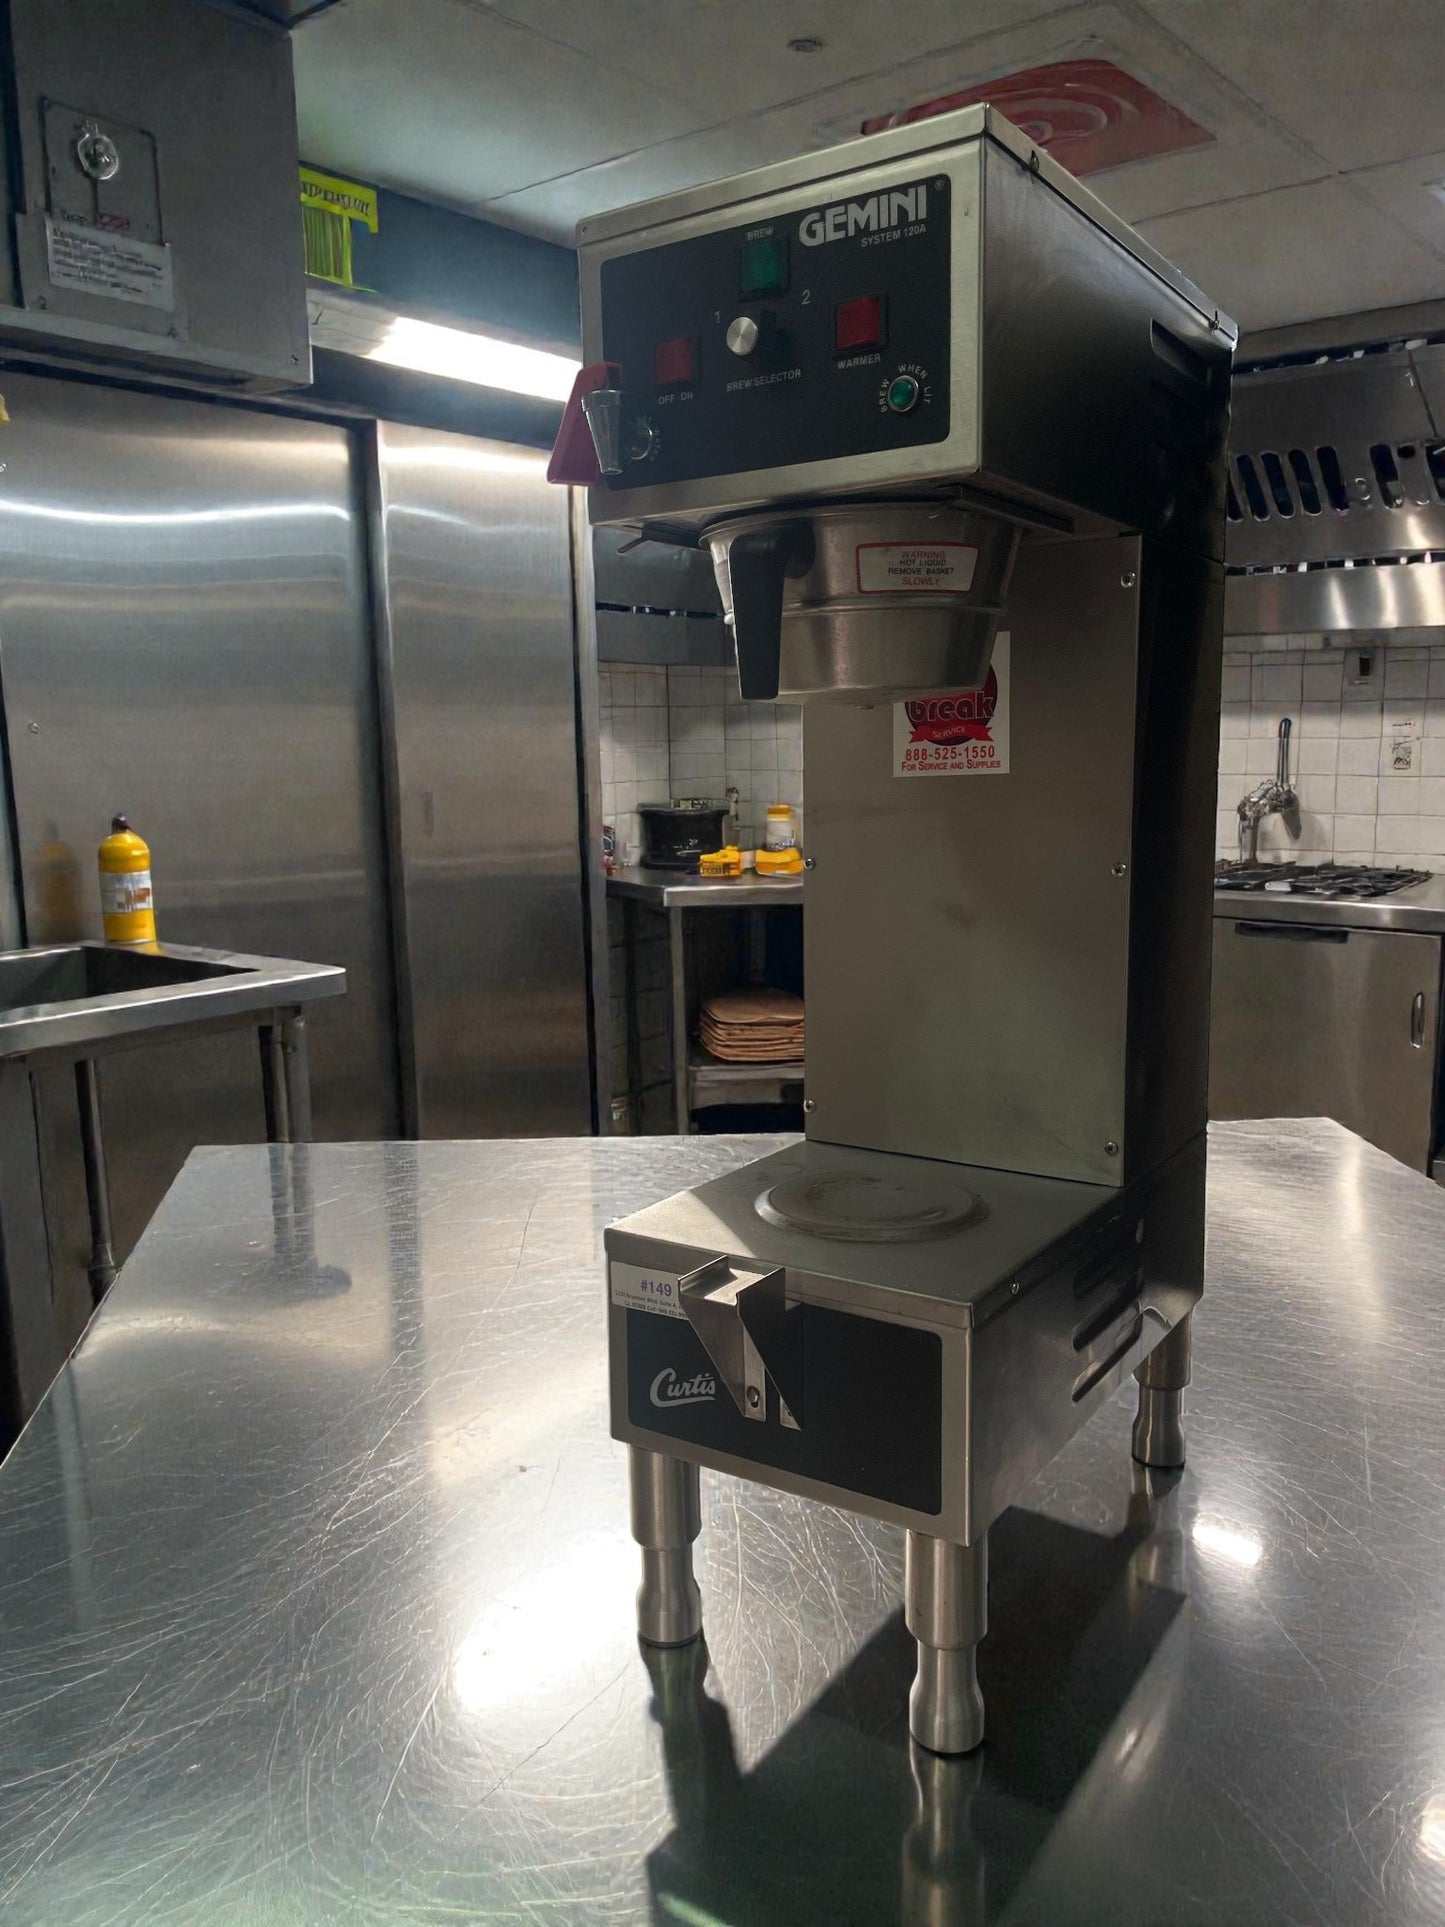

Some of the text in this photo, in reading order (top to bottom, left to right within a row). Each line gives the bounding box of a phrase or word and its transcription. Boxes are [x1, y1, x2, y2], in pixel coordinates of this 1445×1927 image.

[799, 184, 927, 247] GEMINI
[747, 226, 774, 240] BREW
[861, 223, 927, 247] SYSTEM 120A
[802, 289, 811, 305] 2
[837, 353, 881, 370] WARMER
[726, 369, 801, 393] BREW SELECTOR
[880, 364, 932, 413] BREW WHEN LIT
[658, 392, 693, 405] OFF ON
[902, 550, 945, 559] WARNING
[888, 567, 954, 575] REMOVE BASKET
[919, 559, 946, 567] LIQUID
[901, 577, 940, 586] SLOWLY
[905, 745, 995, 761] 888-525-1550
[641, 1280, 672, 1297] #149
[650, 1367, 716, 1408] Curtis
